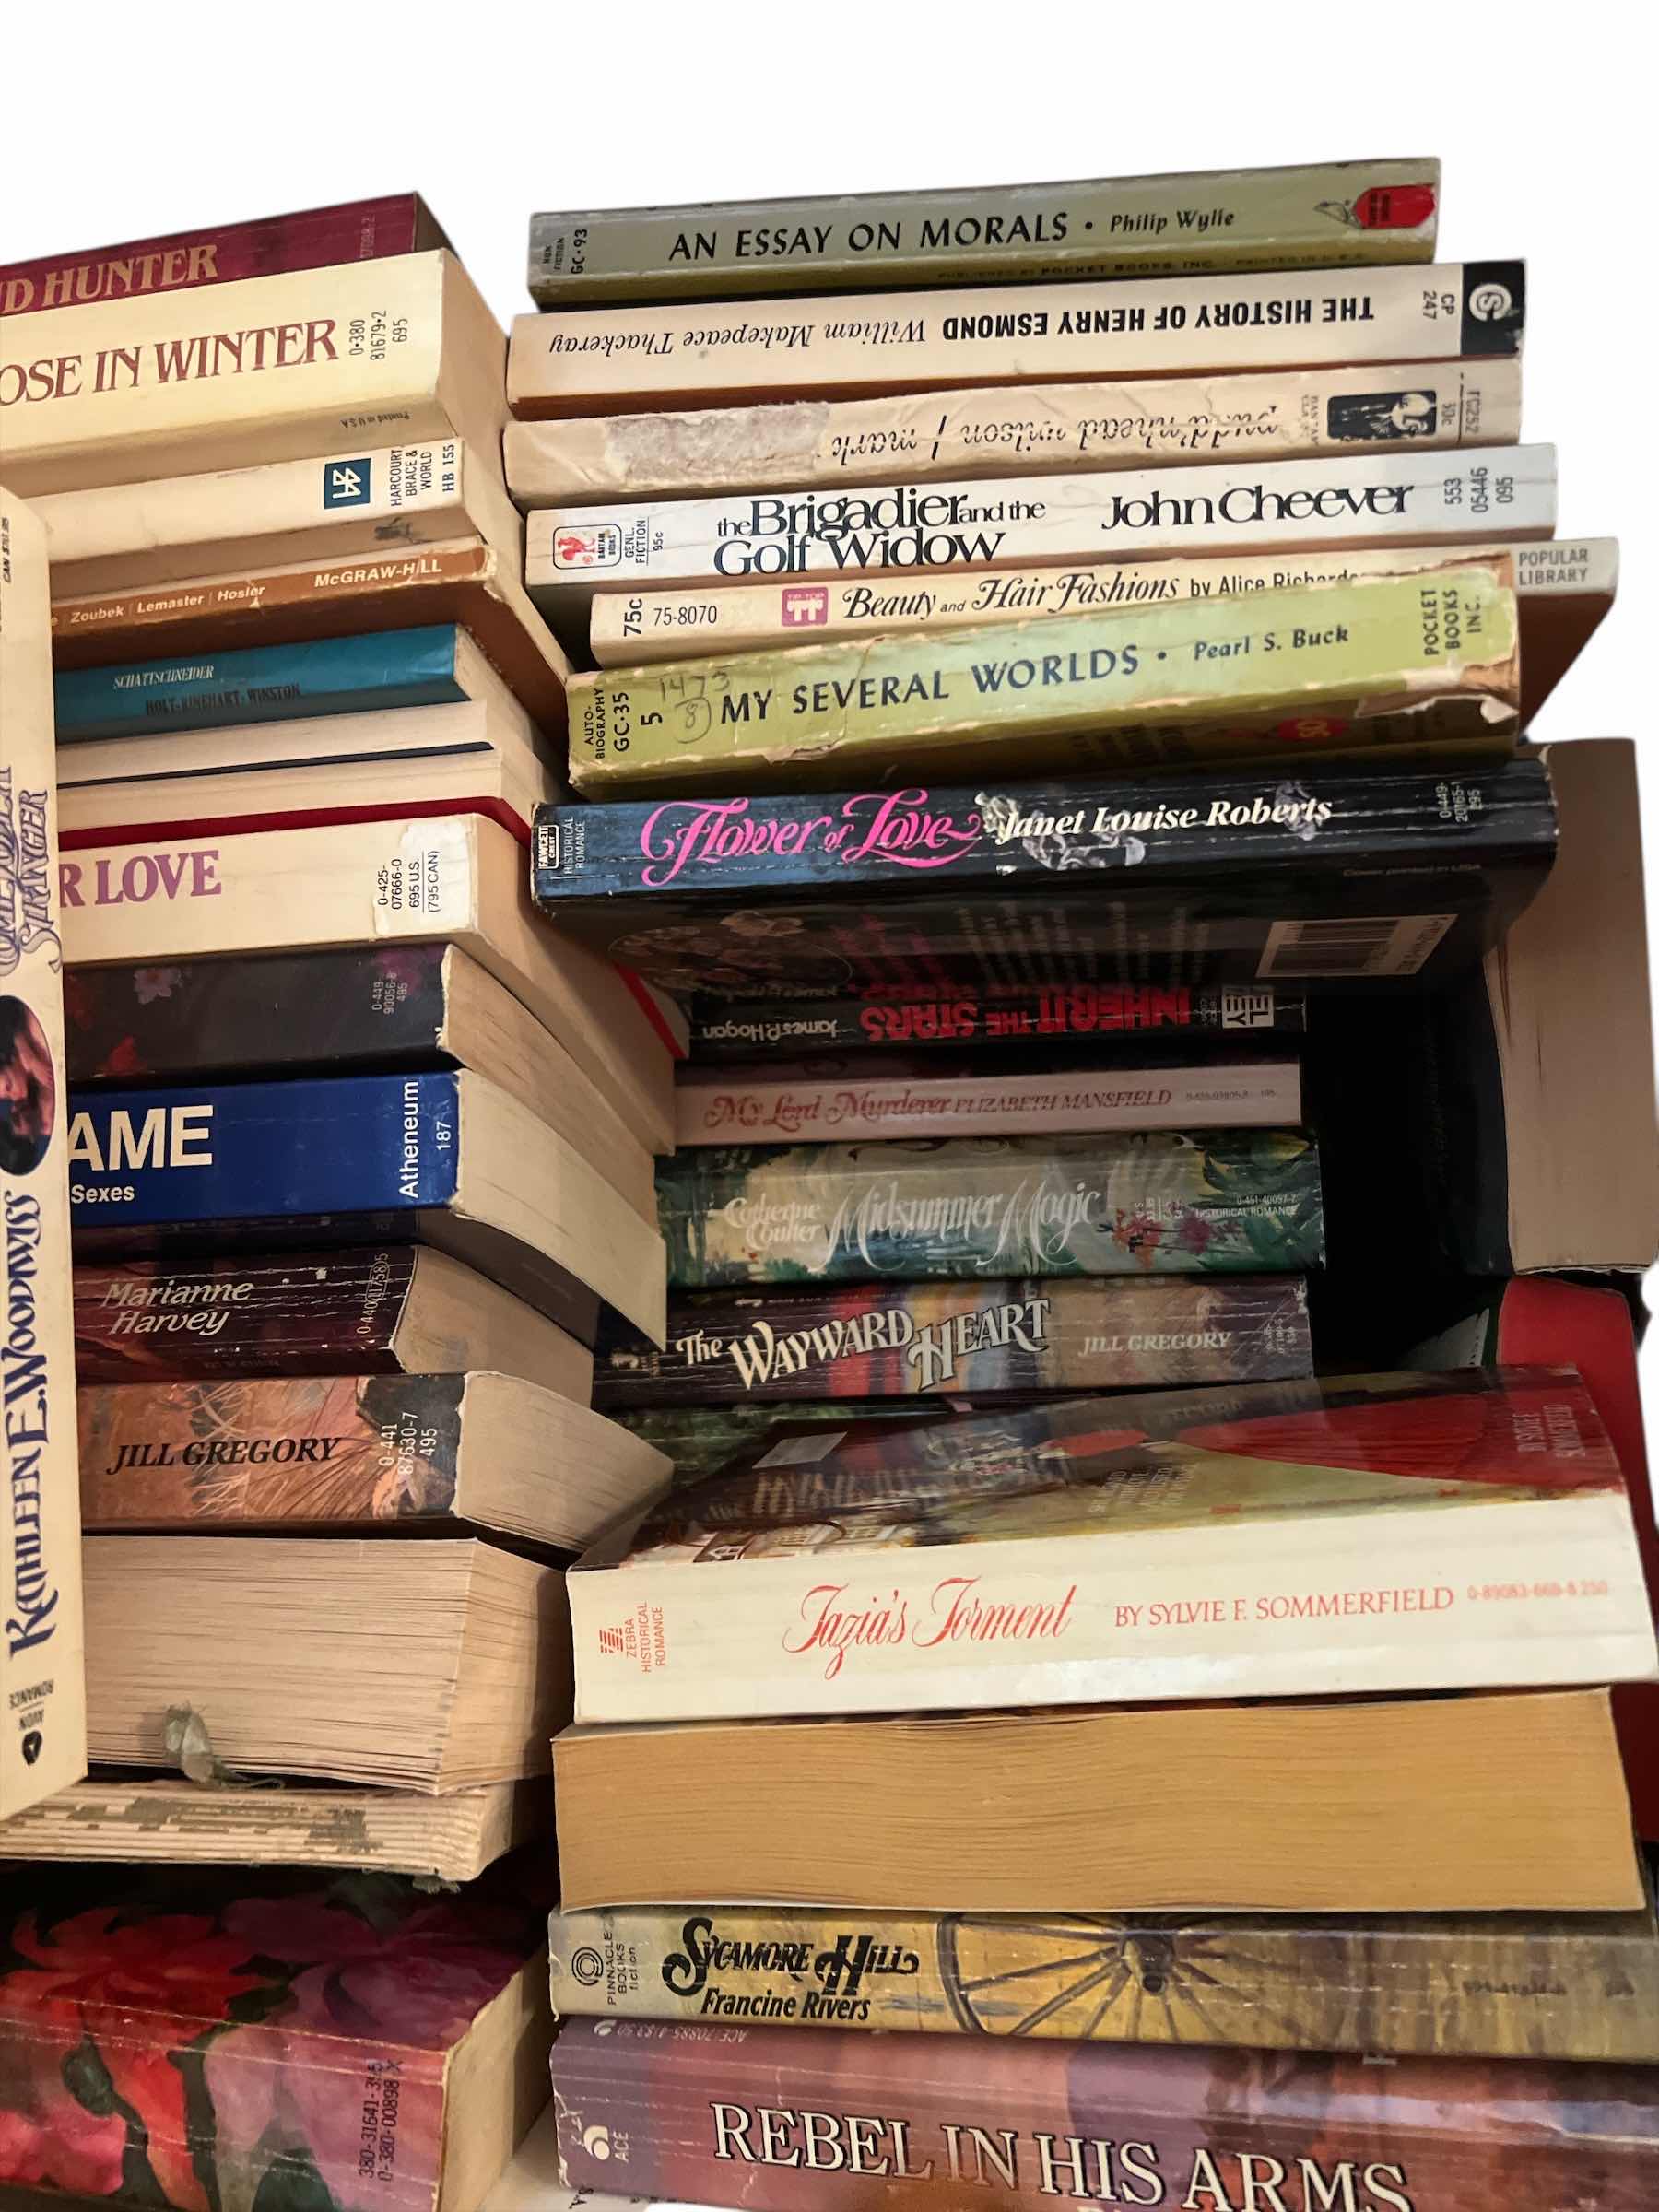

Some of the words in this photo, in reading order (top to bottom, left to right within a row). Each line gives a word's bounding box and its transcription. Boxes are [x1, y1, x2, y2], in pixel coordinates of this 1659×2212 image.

[668, 231, 717, 261] AN
[735, 225, 833, 258] ESSAY
[848, 221, 901, 253] ON
[920, 211, 1067, 248] MORALS
[1110, 209, 1168, 234] Philip
[1176, 209, 1235, 234] Wylie
[0, 278, 35, 315] D
[42, 244, 219, 307] HUNTER
[1057, 307, 1145, 335] HENRY
[1155, 304, 1186, 330] OF
[1194, 300, 1312, 328] HISTORY
[1322, 296, 1374, 322] THE
[1422, 290, 1438, 320] 247
[1439, 293, 1456, 315] CP
[392, 317, 408, 343] 695
[549, 330, 675, 358] Thackeray
[682, 324, 815, 352] Makepeace
[824, 318, 924, 344] William
[943, 312, 1048, 341] ESMOND
[92, 346, 144, 393] IN
[154, 319, 339, 384] WINTER
[420, 452, 432, 490] WORLD
[442, 444, 454, 465] 155
[390, 449, 403, 507] HARCOURT
[405, 464, 418, 497] BRACE
[442, 473, 454, 492] HB
[1444, 477, 1463, 505] 553
[1496, 476, 1513, 503] 095
[717, 517, 751, 538] the
[749, 488, 968, 544] Brigadier
[960, 502, 1005, 524] and
[1009, 499, 1047, 522] the
[1100, 492, 1216, 531] John
[1218, 483, 1414, 523] Cheever
[636, 519, 646, 564] FICTION
[714, 531, 815, 577] Golf
[826, 528, 1006, 570] Widow
[1518, 547, 1589, 566] POPULAR
[314, 559, 443, 588] McGRAW-HILL
[1518, 566, 1589, 586] LIBRARY
[71, 605, 125, 625] Zoubek
[137, 593, 205, 614] Lemaster
[841, 585, 936, 620] Beauty
[940, 599, 965, 614] and
[971, 578, 1049, 611] Hair
[1047, 575, 1180, 614] Fashions
[1190, 578, 1212, 597] by
[1218, 575, 1265, 595] Alice
[624, 598, 643, 637] 75c
[653, 606, 718, 628] 75-8070
[1424, 588, 1438, 657] POCKET
[1444, 588, 1459, 651] BOOKS
[1194, 636, 1251, 661] Pearl
[1264, 632, 1283, 653] S.
[1292, 624, 1349, 648] Buck
[721, 689, 772, 724] MY
[793, 669, 949, 715] SEVERAL
[971, 644, 1139, 693] WORLDS
[594, 688, 606, 760] BIOGRAPHY
[641, 798, 832, 887] Flower
[823, 824, 853, 853] of
[841, 789, 982, 869] Love
[995, 808, 1085, 845] Janet
[1093, 805, 1197, 836] Louise
[1206, 795, 1333, 828] Roberts
[563, 816, 574, 875] HISTORICAL
[575, 820, 586, 869] ROMANCE
[95, 850, 222, 908] LOVE
[391, 858, 404, 911] 07666-0
[428, 850, 441, 883] CAN)
[409, 883, 420, 908] 695
[428, 885, 440, 912] (795
[783, 1018, 839, 1041] James
[859, 1002, 978, 1042] STARS
[986, 1010, 1029, 1037] THE
[1037, 988, 1191, 1034] INHERIT
[701, 1019, 764, 1042] Hogan
[705, 1095, 763, 1127] My
[826, 1089, 952, 1126] Murderer
[953, 1093, 1057, 1115] ELIZABETH
[1059, 1088, 1172, 1111] MANSFIELD
[398, 1081, 418, 1199] Atheneum
[436, 1121, 452, 1151] 187
[71, 1184, 135, 1204] Sexes
[809, 1181, 1007, 1272] Midsummer
[976, 1180, 1103, 1266] Magic
[0, 1191, 49, 1397] WOODIWISS
[100, 1278, 255, 1309] Marianne
[110, 1310, 230, 1336] Harvey
[675, 1329, 723, 1365] The
[726, 1309, 914, 1391] WAYWARD
[906, 1298, 1051, 1391] HEART
[1078, 1335, 1124, 1358] JILL
[1126, 1331, 1231, 1353] GREGORY
[6, 1387, 50, 1443] E.
[106, 1443, 176, 1475] JILL
[182, 1437, 341, 1465] GREGORY
[397, 1411, 418, 1476] 87630-7
[419, 1427, 438, 1457] 495
[5, 1443, 57, 1657] KATHLEEN
[626, 1618, 636, 1659] ZEBRA
[641, 1601, 652, 1673] HISTORICAL
[654, 1607, 665, 1667] ROMANCE
[782, 1583, 909, 1680] Tazia's
[912, 1577, 1077, 1648] Torment
[1114, 1604, 1143, 1629] BY
[1148, 1600, 1226, 1627] SYLVIE
[1233, 1598, 1248, 1622] F.
[1255, 1586, 1453, 1621] SOMMERFIELD
[604, 1932, 616, 2006] PINNACLE
[616, 1943, 627, 1994] BOOKS
[662, 1916, 814, 1997] SYCAMORE
[814, 1935, 920, 1997] HILLS
[700, 1988, 797, 2018] Francine
[800, 1991, 871, 2021] Rivers
[614, 2130, 630, 2163] ACE
[709, 2101, 933, 2181] REBEL
[941, 2124, 1018, 2190] IN
[1032, 2133, 1165, 2207] HIS
[1182, 2146, 1414, 2212] ARMS
